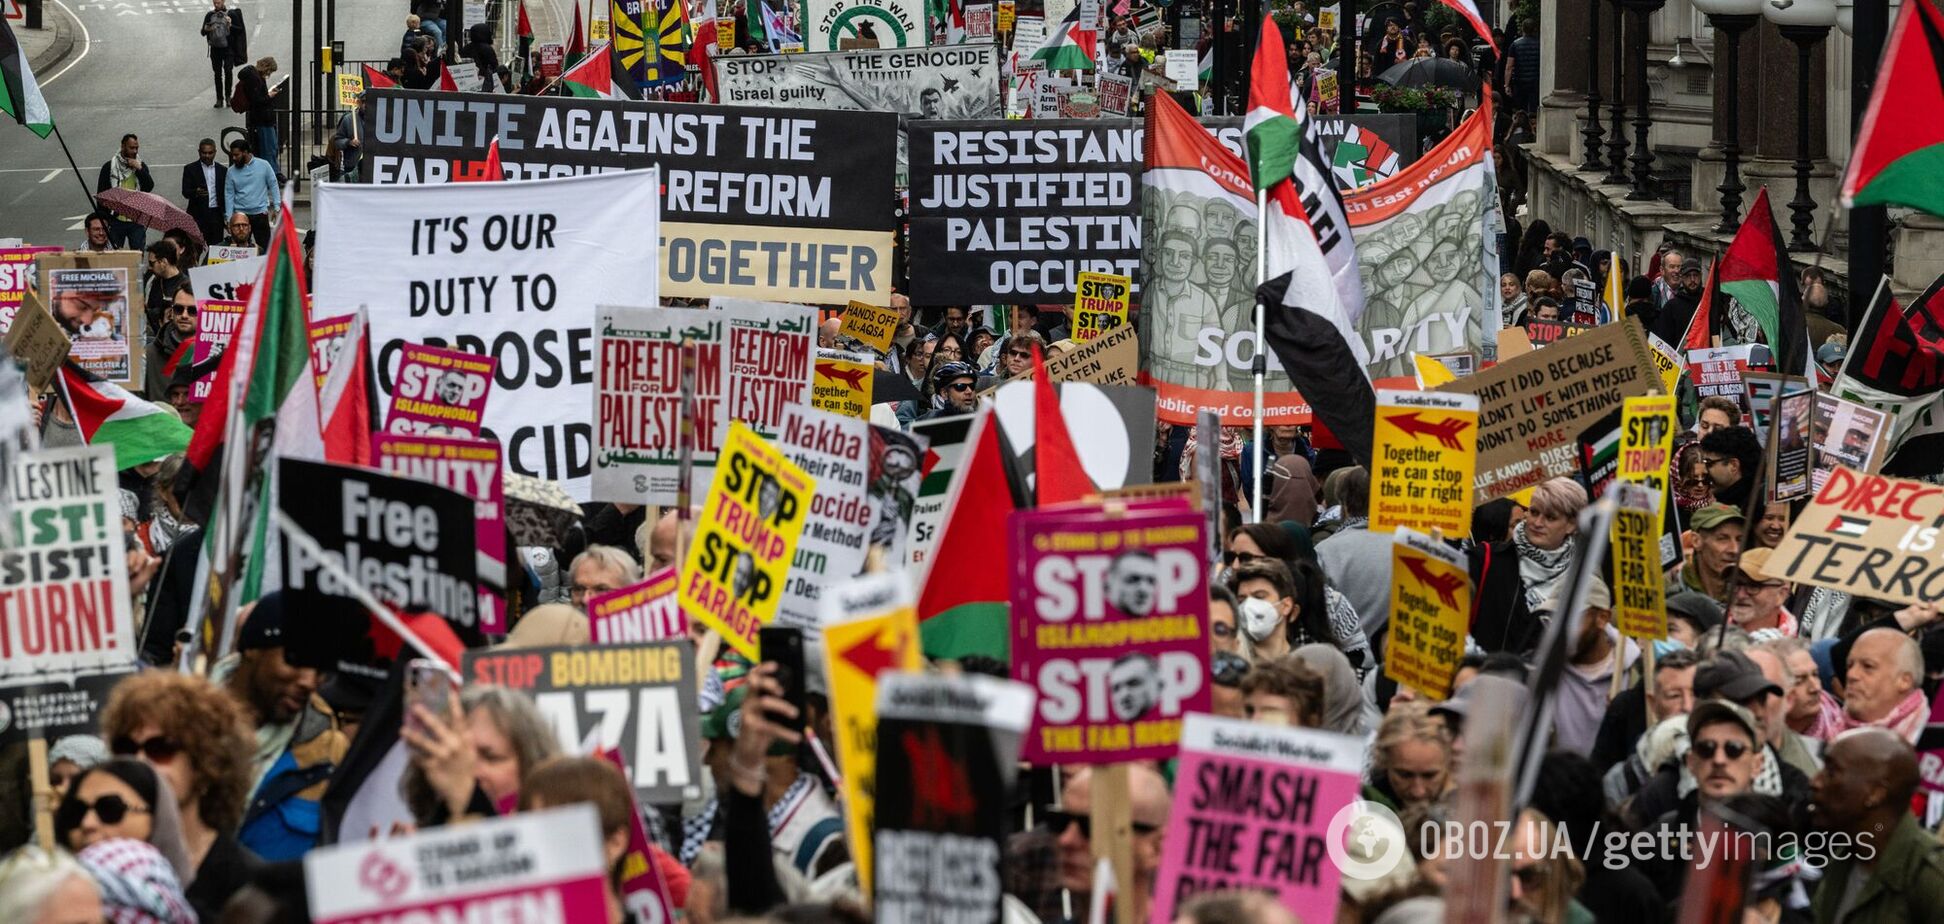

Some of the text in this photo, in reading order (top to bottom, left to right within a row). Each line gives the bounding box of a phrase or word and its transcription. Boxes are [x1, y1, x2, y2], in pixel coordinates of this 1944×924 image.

[819, 1, 915, 34] STOP WAR
[727, 50, 990, 76] STOP THE GENOCIDE
[730, 86, 825, 102] Israel guilty
[375, 97, 817, 162] UNITE AGAINST THE
[667, 168, 832, 219] REFORM
[920, 172, 1132, 208] JUSTIFIED
[1371, 186, 1414, 209] East
[411, 213, 558, 256] IT'S OUR
[61, 273, 115, 282] FREE MICHAEL
[1081, 280, 1125, 300] STP
[409, 273, 558, 318] DUTY TO
[1080, 297, 1124, 313] TRUMP
[846, 319, 885, 341] AL-AQSA
[847, 302, 898, 328] HANDS OFF
[1078, 312, 1122, 330] STP
[1528, 322, 1562, 341] STOP
[600, 338, 721, 396] FREEDM
[734, 364, 758, 376] FOR
[817, 350, 863, 364] Socialist Worker
[1702, 360, 1737, 373] UNITE THE
[400, 362, 487, 407] STP
[631, 383, 660, 393] FOR
[1474, 379, 1506, 405] HAT
[1517, 371, 1545, 391] DID
[1548, 343, 1615, 381] BECAUSE
[1558, 365, 1638, 402] WITH MYSELF
[1701, 371, 1741, 384] STRUGGLES
[825, 400, 863, 414] can stop
[1394, 395, 1462, 408] Socialist Worker
[1698, 385, 1719, 397] FIGHT
[395, 397, 478, 423] ISLAMOPHOBIA
[599, 393, 721, 452] PALESTNE
[1517, 419, 1537, 438] DO
[1543, 387, 1622, 428] SOMETHING
[783, 413, 862, 461] Nakba
[1627, 415, 1670, 448] STP
[1383, 443, 1442, 465] Together
[1625, 448, 1666, 473] TRUMP
[725, 450, 798, 528] STP
[829, 461, 863, 487] Plan
[1382, 465, 1399, 479] we
[1404, 466, 1428, 481] can
[1432, 465, 1463, 486] stop
[1488, 467, 1547, 495] PRISONER
[1547, 459, 1574, 477] FOR
[1381, 481, 1464, 504] the far right
[341, 477, 440, 552] Free
[713, 490, 787, 564] TRUMP
[811, 521, 863, 550] Method
[1897, 523, 1941, 552] IS
[288, 541, 475, 630] Palestine
[698, 532, 772, 607] STP
[1033, 548, 1200, 623] STP
[596, 590, 680, 645] UNITY
[685, 570, 762, 646] FARAGE
[1035, 614, 1201, 649] ISLAMOPHOBIA
[473, 645, 682, 689] STOP BOMBING
[1037, 650, 1204, 724] STP
[1041, 724, 1131, 752] THE FAR
[1192, 759, 1319, 826] SMASH
[1184, 817, 1326, 888] THE FAR
